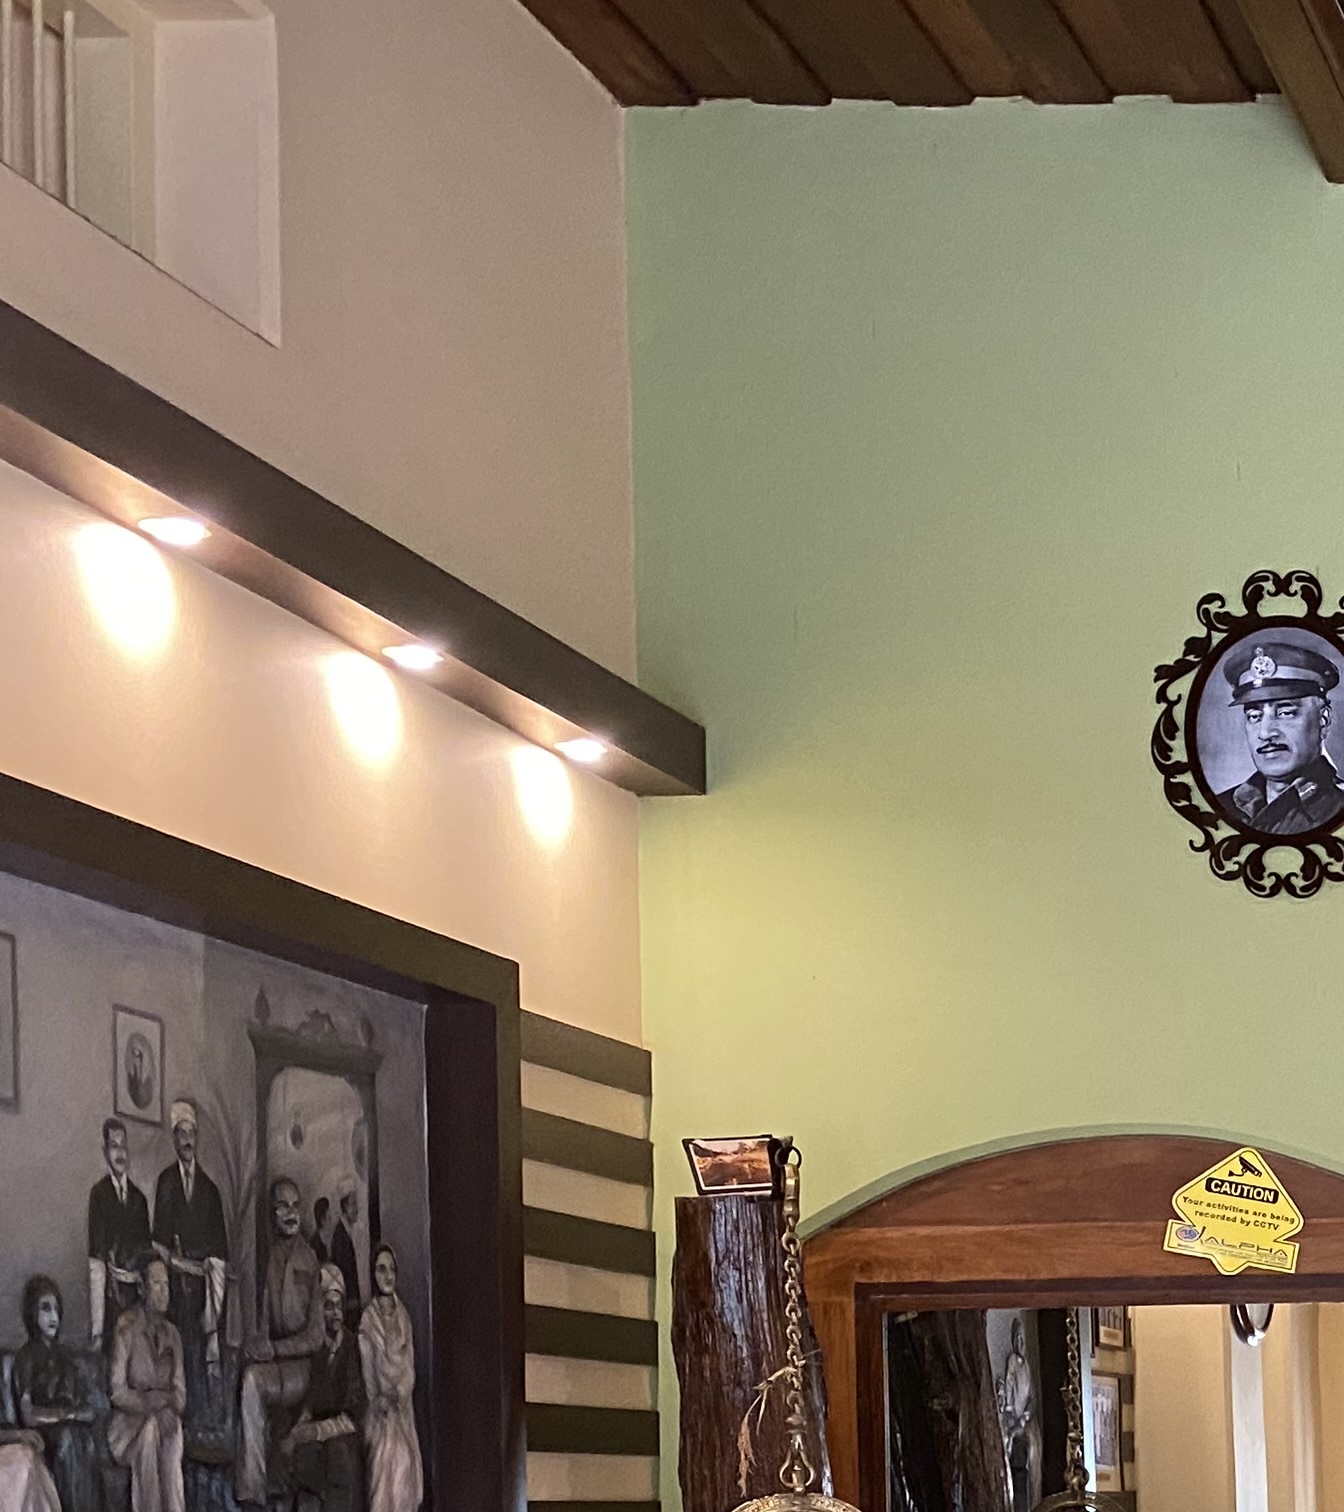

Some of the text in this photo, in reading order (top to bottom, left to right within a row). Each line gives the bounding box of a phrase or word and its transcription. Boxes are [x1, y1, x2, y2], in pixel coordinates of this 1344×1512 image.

[1210, 1179, 1275, 1203] CAUTION
[1182, 1196, 1296, 1225] Your activities are being
[1194, 1210, 1280, 1231] recorded by CCTV
